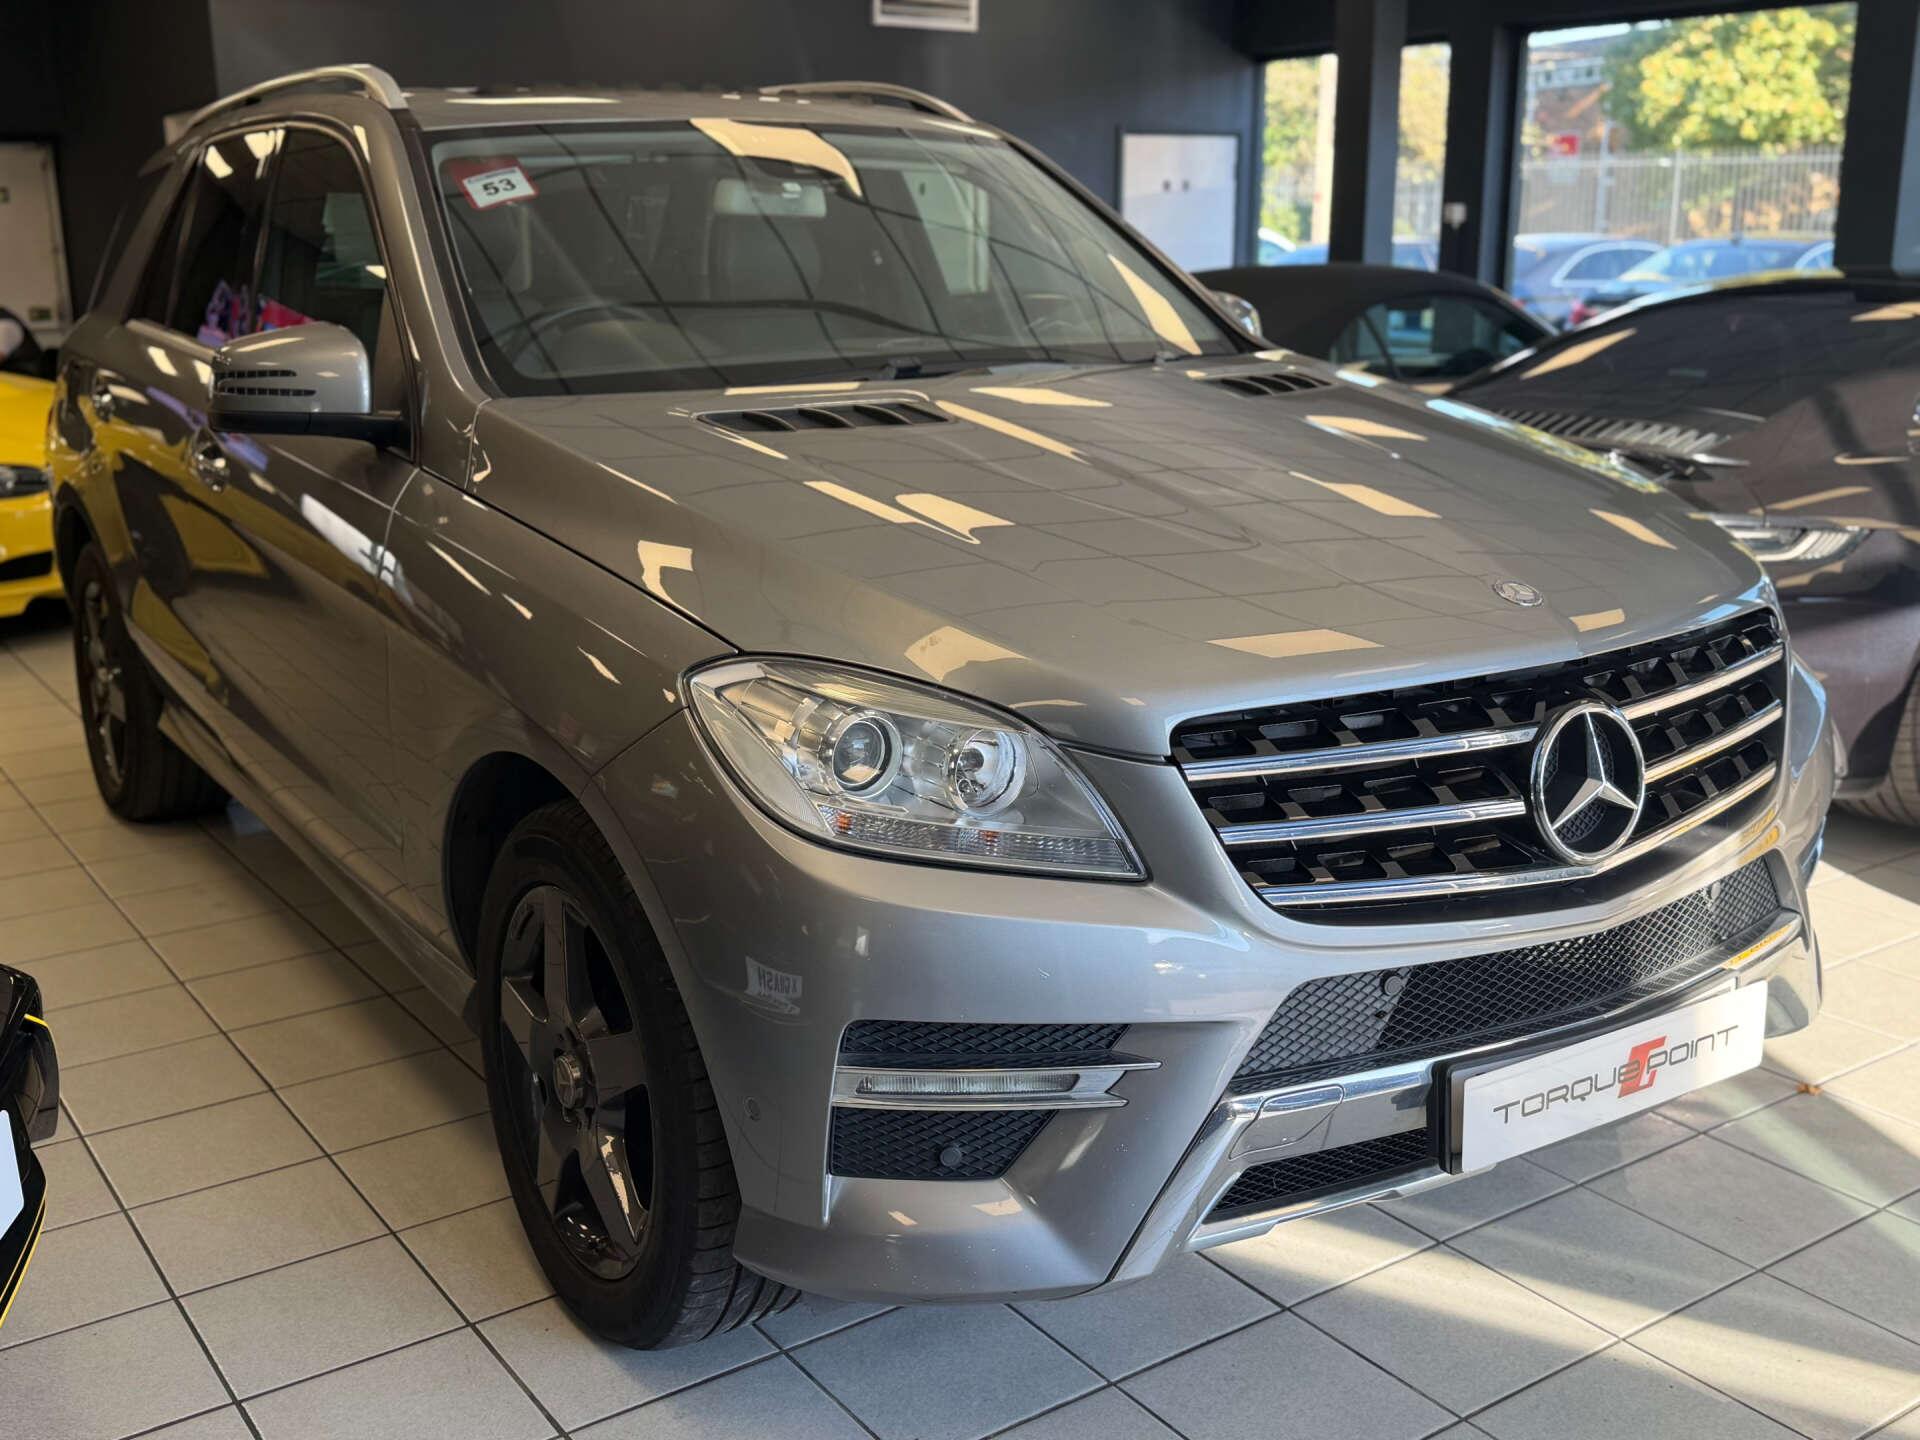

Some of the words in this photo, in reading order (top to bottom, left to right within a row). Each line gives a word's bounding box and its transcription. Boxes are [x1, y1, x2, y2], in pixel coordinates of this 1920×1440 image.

[482, 178, 516, 196] 53
[1493, 1058, 1641, 1124] TORQUE
[1646, 1025, 1739, 1075] POINT
